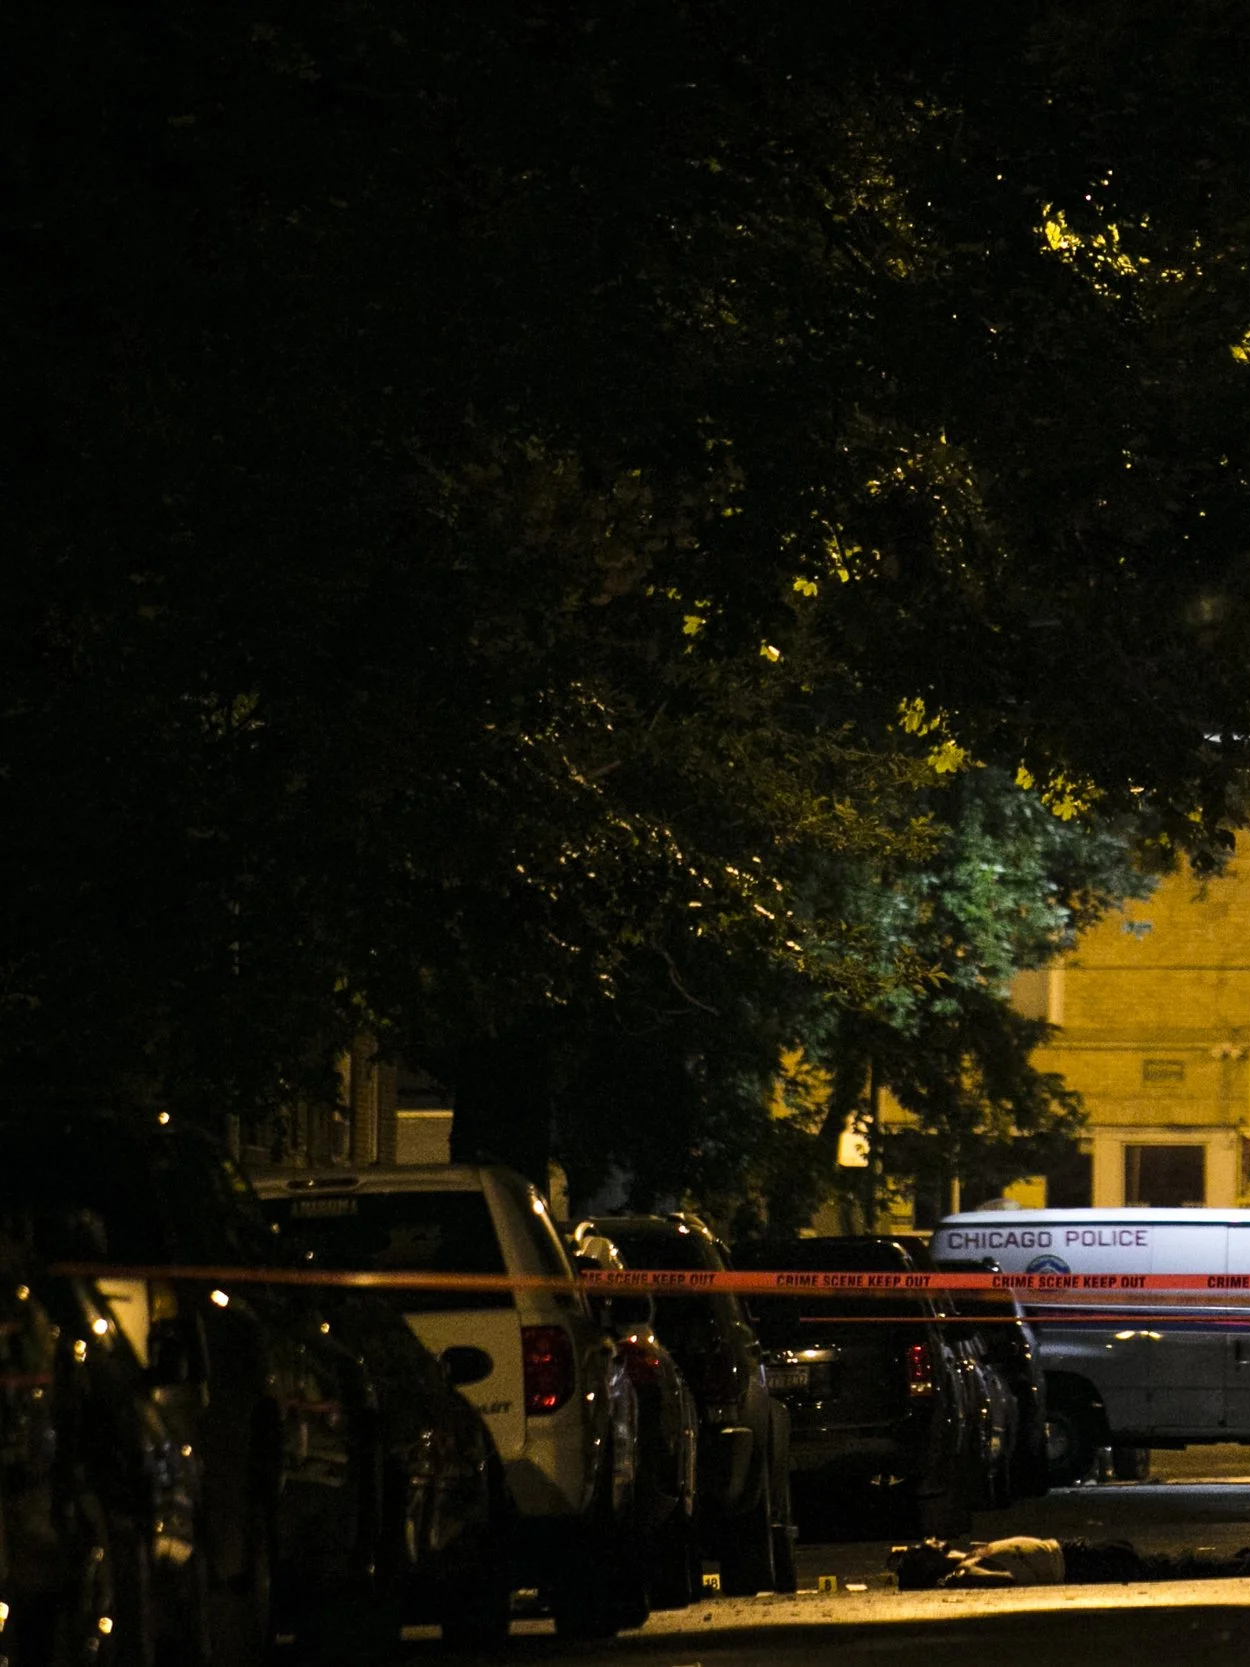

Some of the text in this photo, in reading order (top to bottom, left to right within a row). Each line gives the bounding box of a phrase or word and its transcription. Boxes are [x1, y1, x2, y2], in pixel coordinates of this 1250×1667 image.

[948, 1230, 1148, 1249] CHICAGO POLICE
[606, 1274, 647, 1285] SCENE
[652, 1274, 685, 1285] KEEP
[690, 1274, 716, 1285] OUT
[777, 1275, 931, 1287] CRIME SCENE KEEP OUT
[993, 1276, 1146, 1288] CRIME SCENE KEEP OUT
[1208, 1276, 1248, 1288] CRIME
